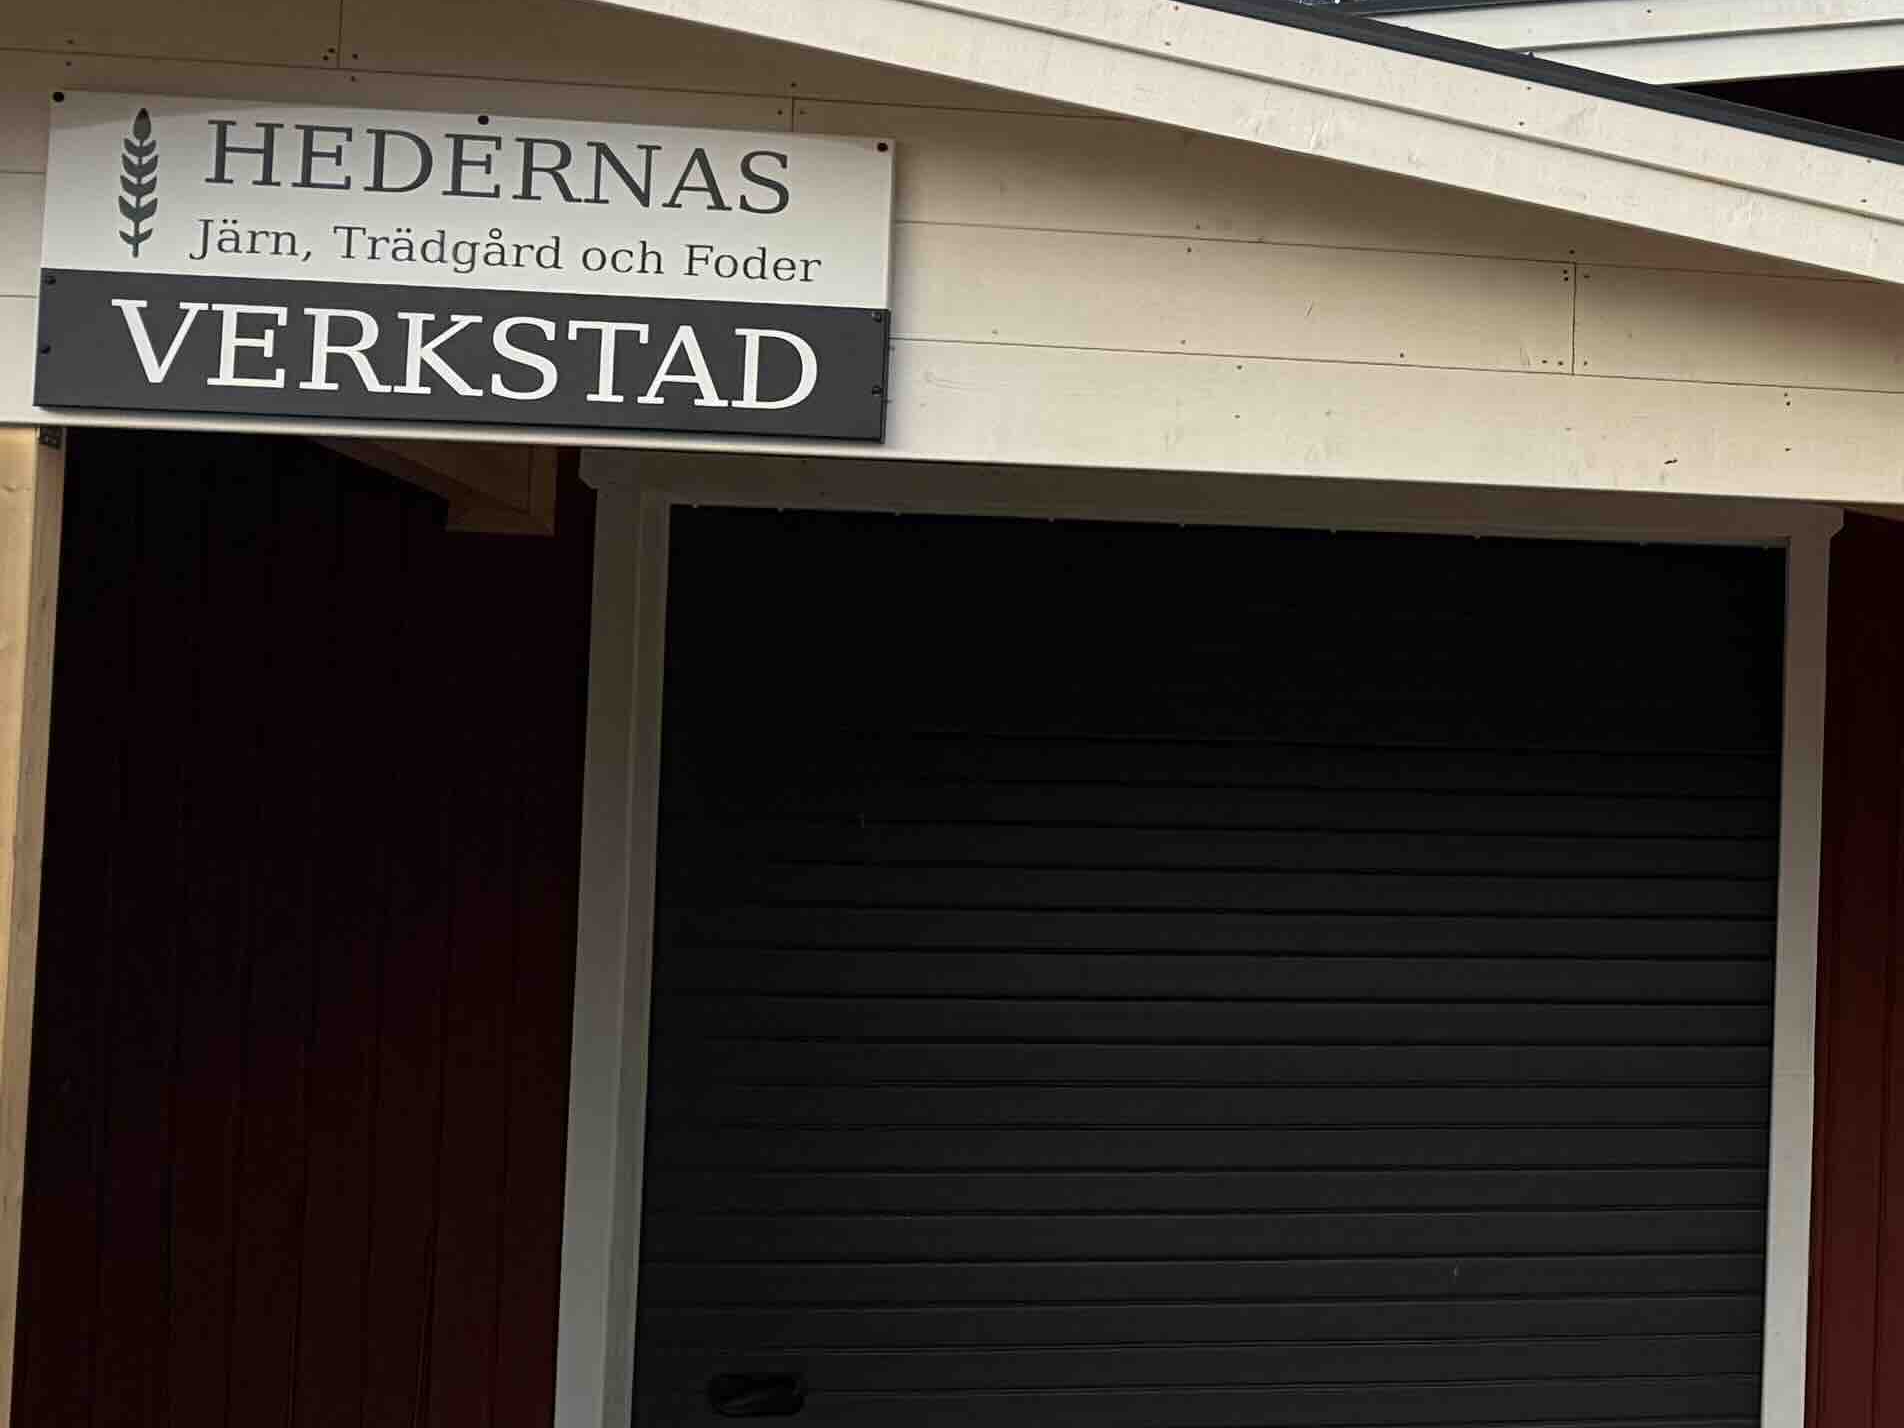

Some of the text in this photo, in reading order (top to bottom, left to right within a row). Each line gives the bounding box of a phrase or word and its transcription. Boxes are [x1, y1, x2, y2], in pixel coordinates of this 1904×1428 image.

[204, 119, 790, 214] HEDERNAS
[189, 219, 822, 283] Järn, Trädgård och Foder
[111, 298, 819, 412] VERKSTAD
